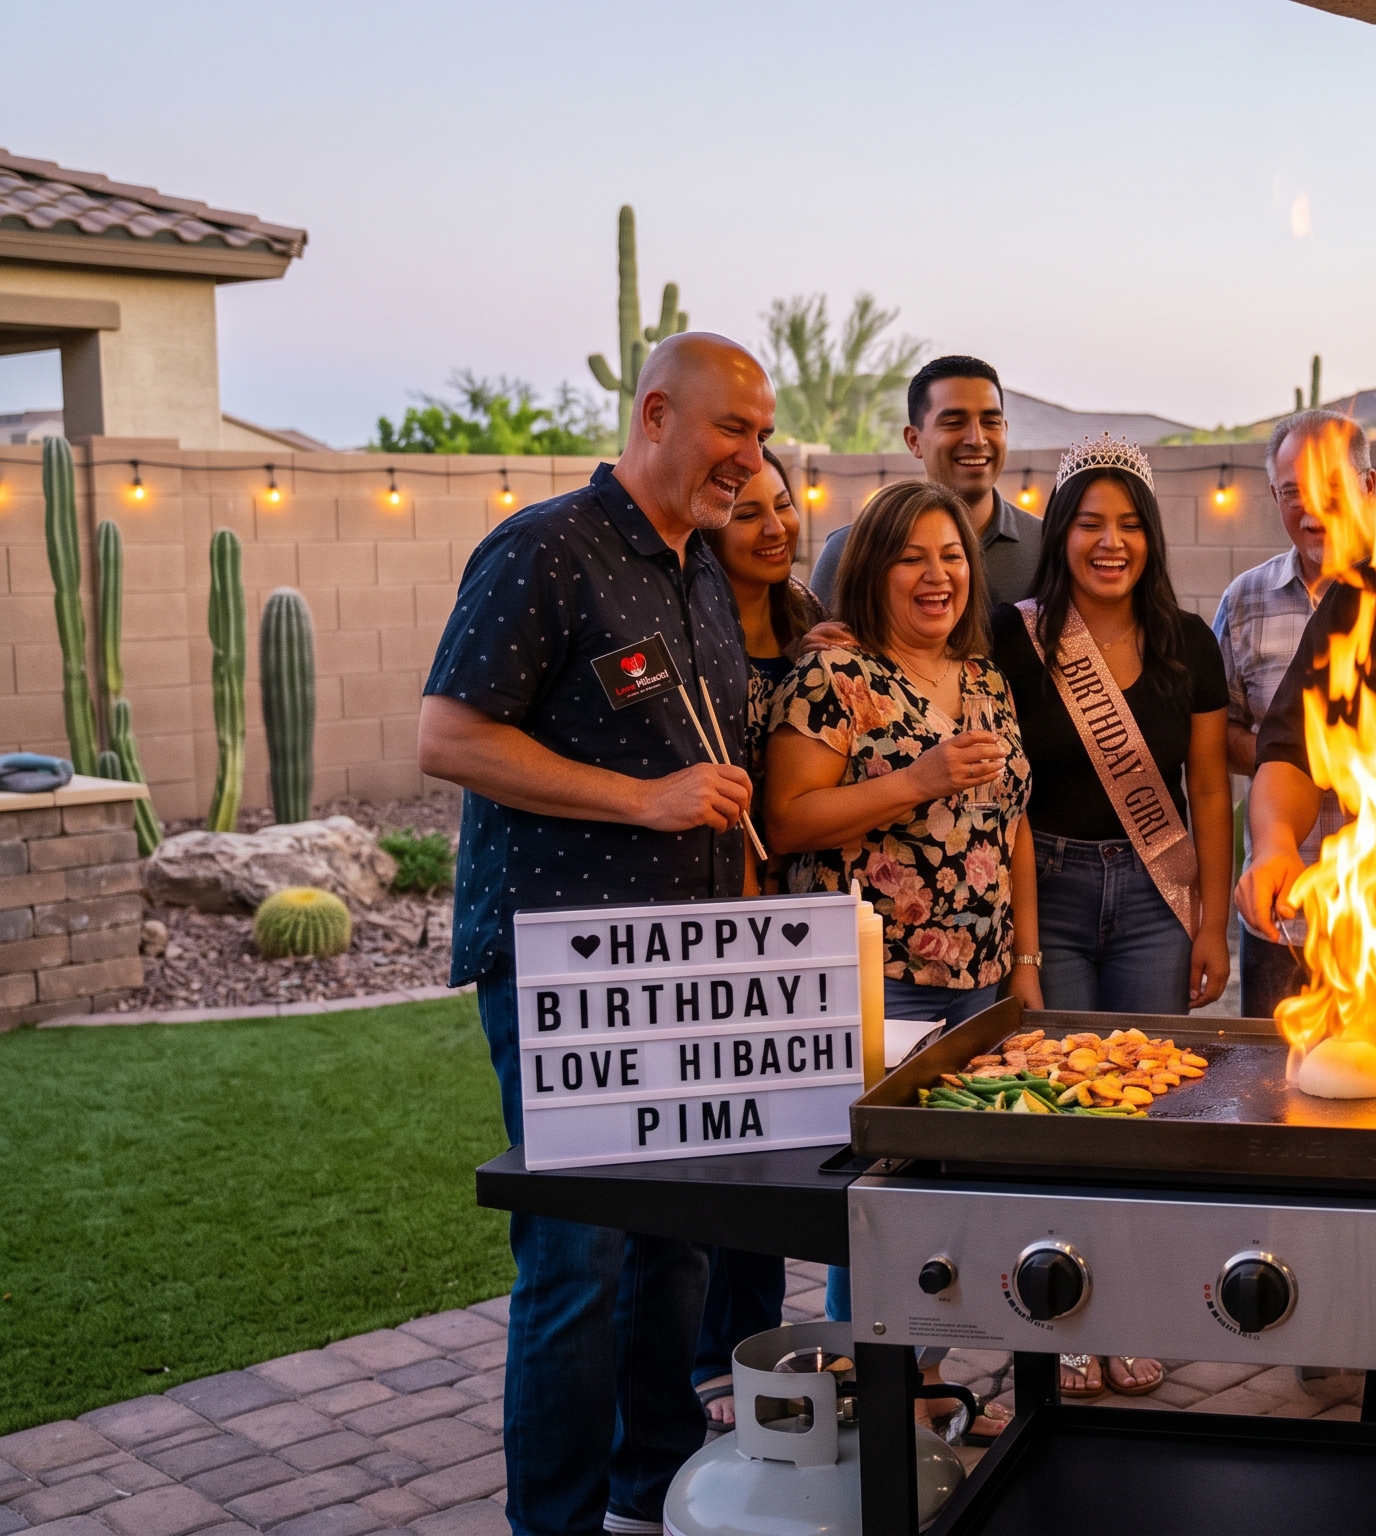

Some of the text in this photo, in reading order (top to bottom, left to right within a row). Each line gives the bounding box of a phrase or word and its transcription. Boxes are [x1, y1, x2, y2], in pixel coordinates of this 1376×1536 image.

[1060, 655, 1171, 847] BIRTHDAY GIRL
[610, 916, 772, 965] HAPPY
[536, 973, 828, 1032] BIRTHDAY!
[535, 1032, 853, 1093] LOVE HIBACHI
[637, 1098, 764, 1146] PIMA
